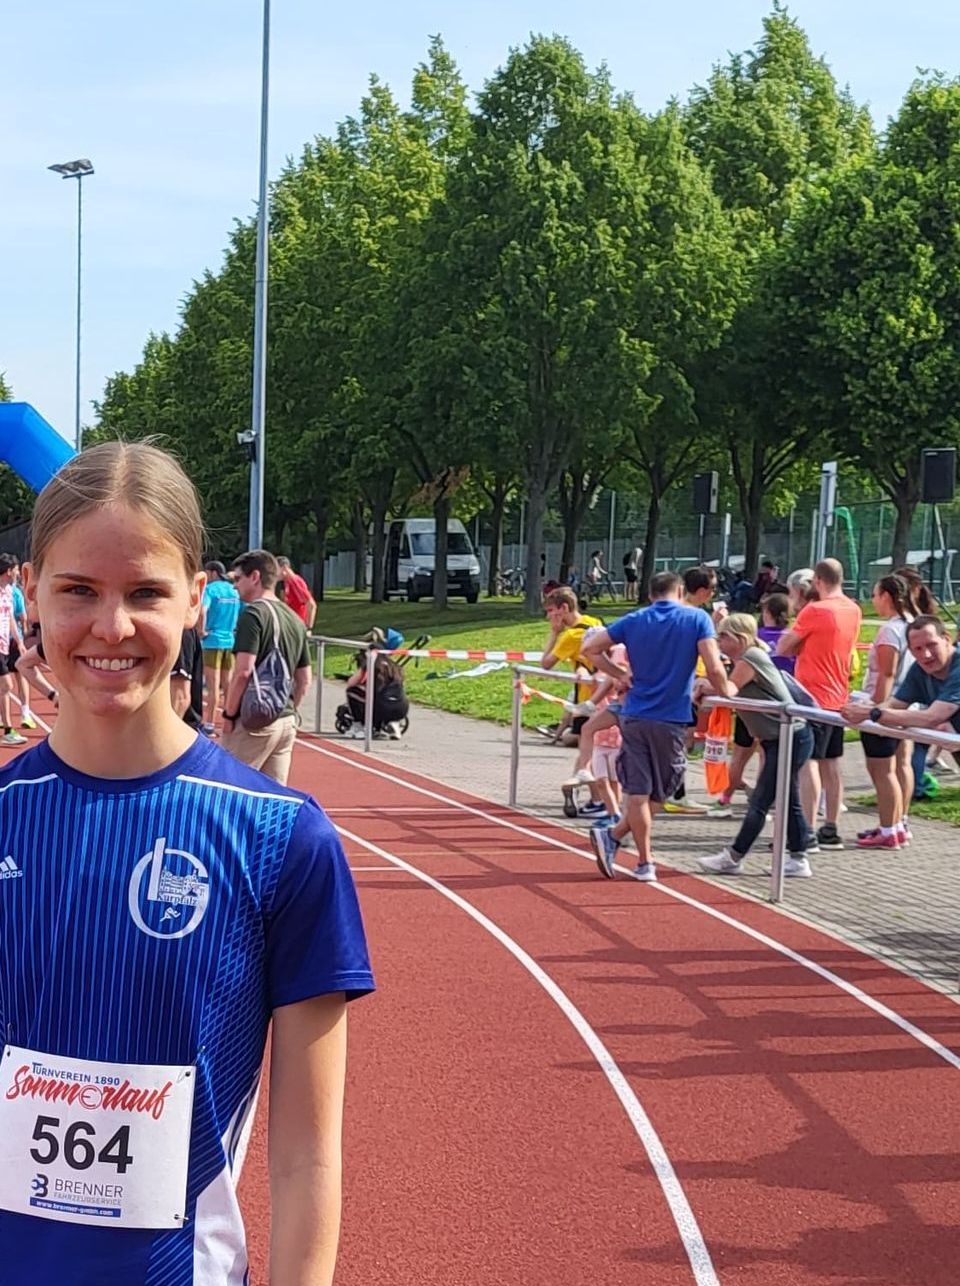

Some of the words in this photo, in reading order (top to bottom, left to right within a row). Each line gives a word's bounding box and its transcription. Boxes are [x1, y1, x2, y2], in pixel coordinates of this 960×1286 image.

[94, 1075, 121, 1087] 1890
[29, 1114, 133, 1174] 564
[54, 1178, 124, 1198] BRENNER
